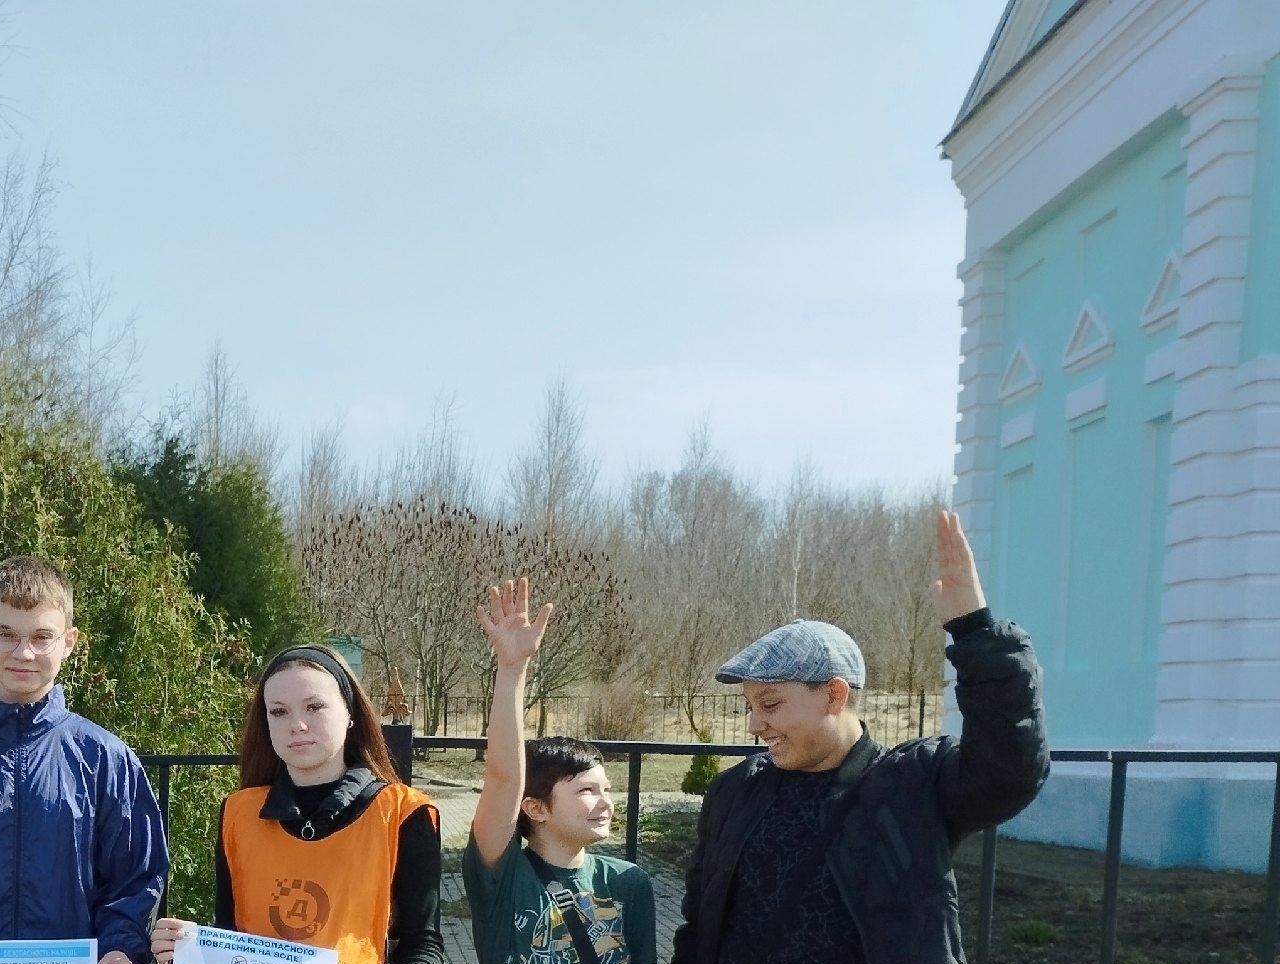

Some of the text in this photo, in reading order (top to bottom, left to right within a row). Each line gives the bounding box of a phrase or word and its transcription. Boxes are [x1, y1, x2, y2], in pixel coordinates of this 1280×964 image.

[198, 939, 300, 963] ПОВЕДЕНИЯ НА ВОДЕ
[199, 929, 316, 956] ПРАВИЛА БЕЗОПАСНОГО
